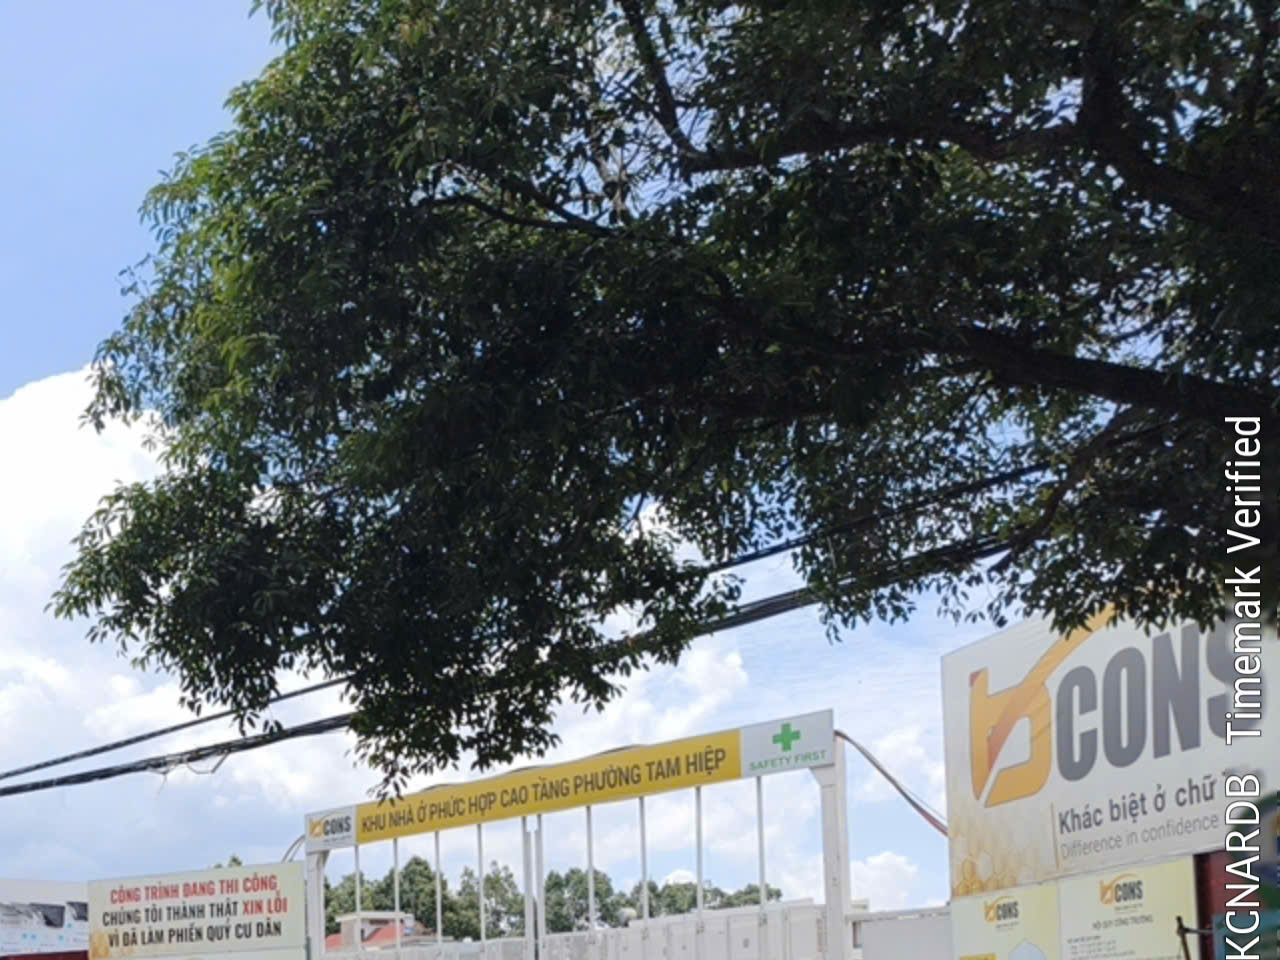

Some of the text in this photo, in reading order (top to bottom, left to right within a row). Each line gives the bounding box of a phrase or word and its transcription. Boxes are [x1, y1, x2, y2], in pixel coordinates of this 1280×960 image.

[749, 749, 827, 771] SAFETY FIRST
[361, 813, 385, 834] KHU
[388, 806, 414, 829] NHÀ
[429, 796, 466, 820] PHỨC
[469, 792, 497, 817] HỢP
[500, 784, 528, 810] CAO
[532, 776, 570, 802] TẦNG
[573, 764, 642, 796] PHƯỜNG
[645, 756, 682, 782] TAM
[686, 744, 726, 776] HIỆP
[1058, 803, 1103, 835] Khác
[1109, 792, 1148, 824] biệt
[1153, 783, 1166, 812] ở
[1174, 774, 1218, 808] chữ
[1060, 813, 1219, 859] Difference in confidence
[220, 879, 239, 895] THI
[242, 898, 262, 915] XIN
